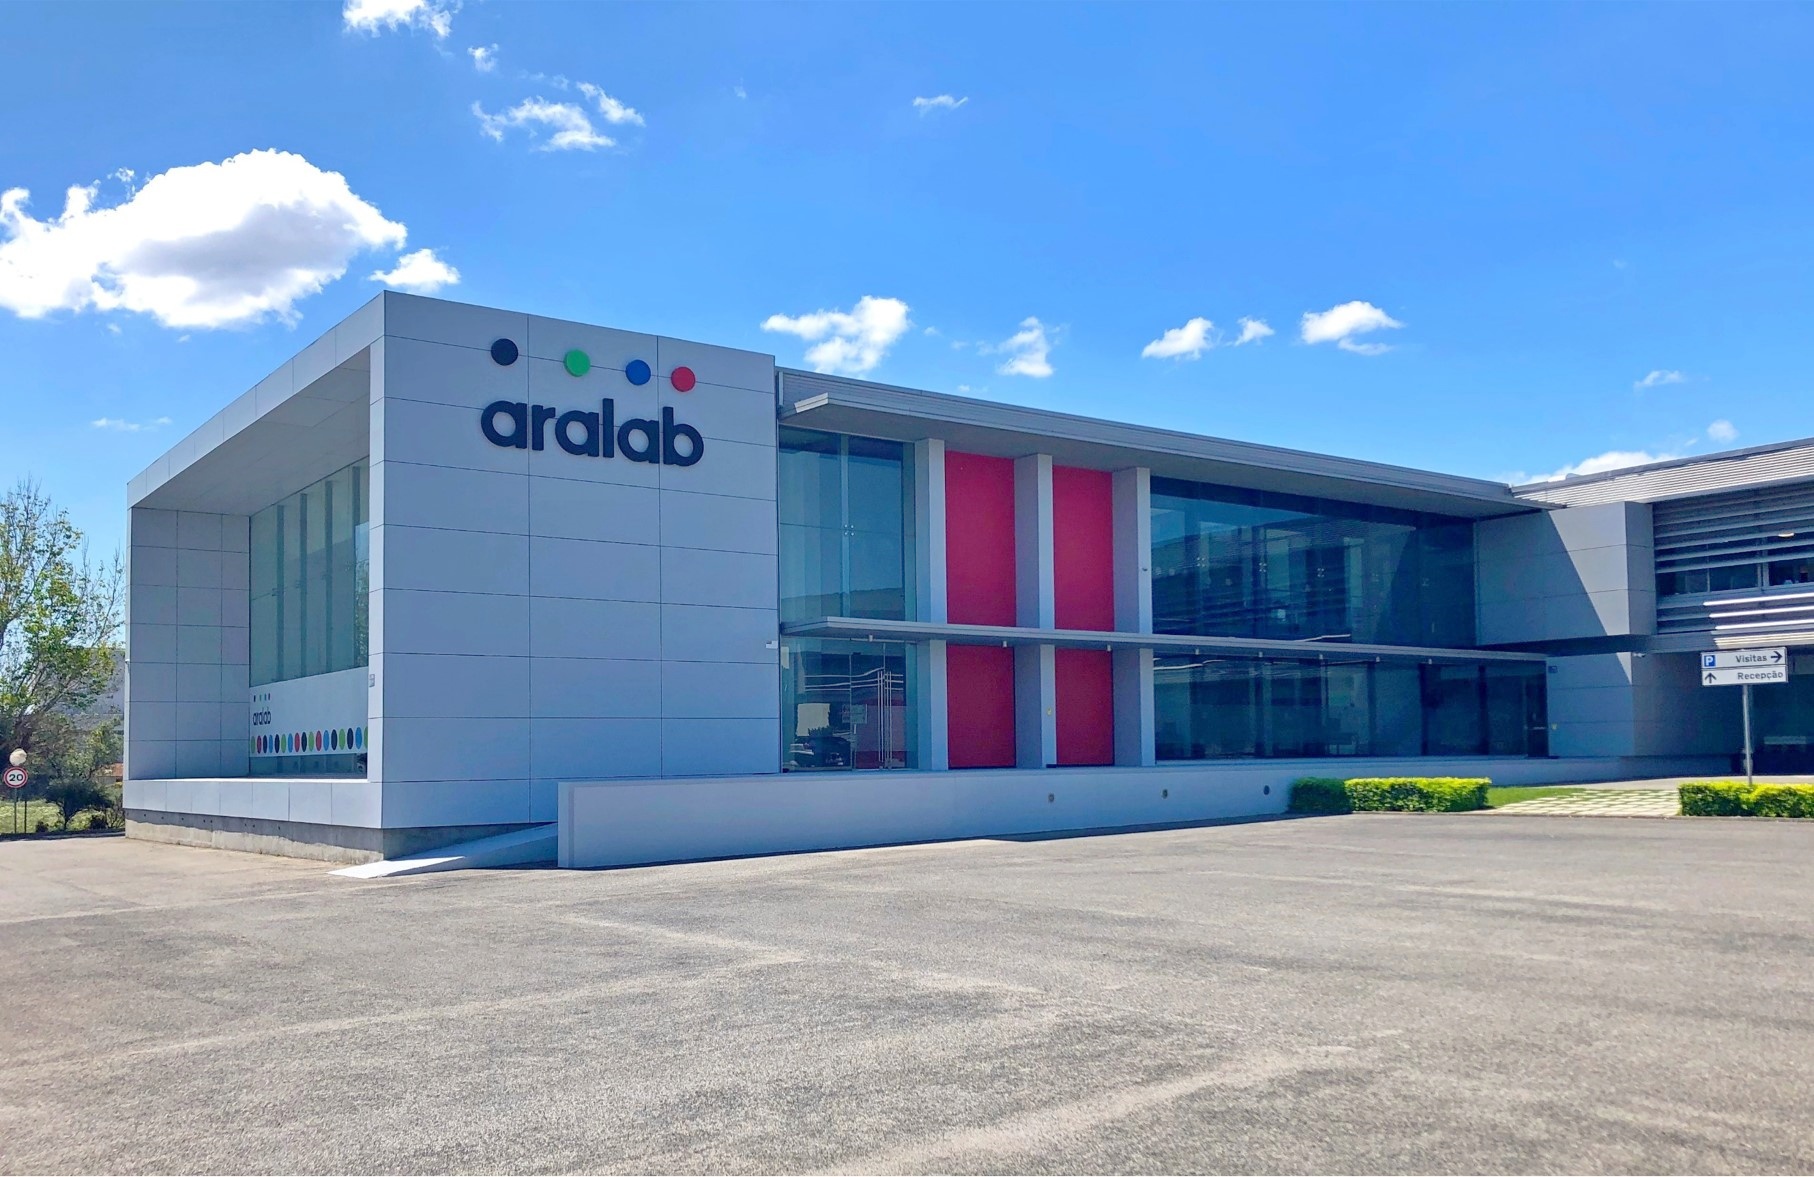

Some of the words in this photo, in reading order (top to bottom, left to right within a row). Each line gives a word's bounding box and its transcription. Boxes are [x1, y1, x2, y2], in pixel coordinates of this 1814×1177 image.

[481, 398, 704, 467] aralab
[1705, 656, 1713, 666] P
[1736, 655, 1767, 663] Visitas
[1737, 671, 1784, 680] Recepção
[253, 706, 271, 725] aralab
